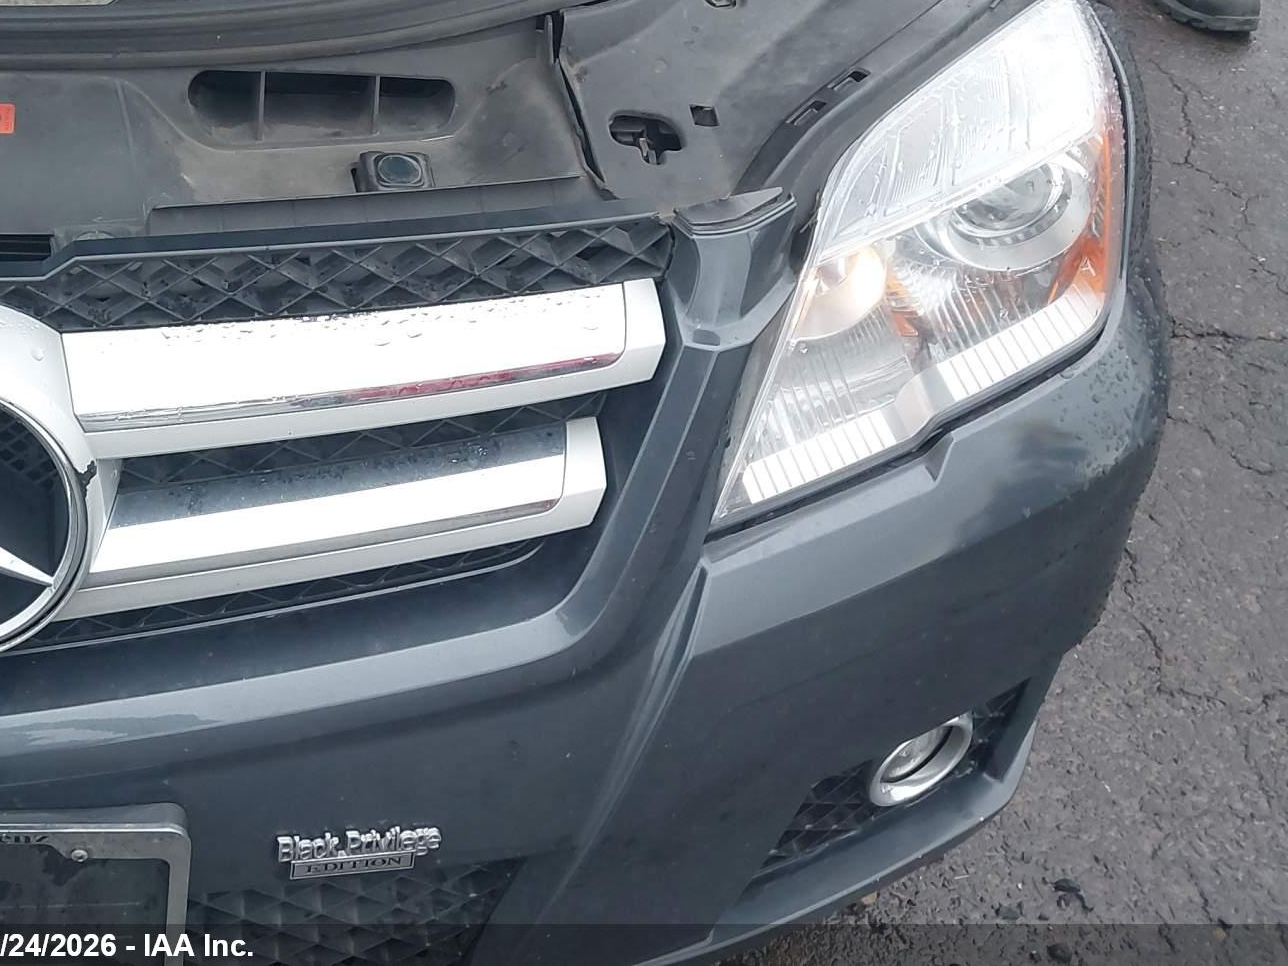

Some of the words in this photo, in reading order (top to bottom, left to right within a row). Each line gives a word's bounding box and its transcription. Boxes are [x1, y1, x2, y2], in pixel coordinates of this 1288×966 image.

[277, 832, 339, 863] Black
[346, 825, 442, 857] Privilege
[305, 856, 402, 875] EDITION
